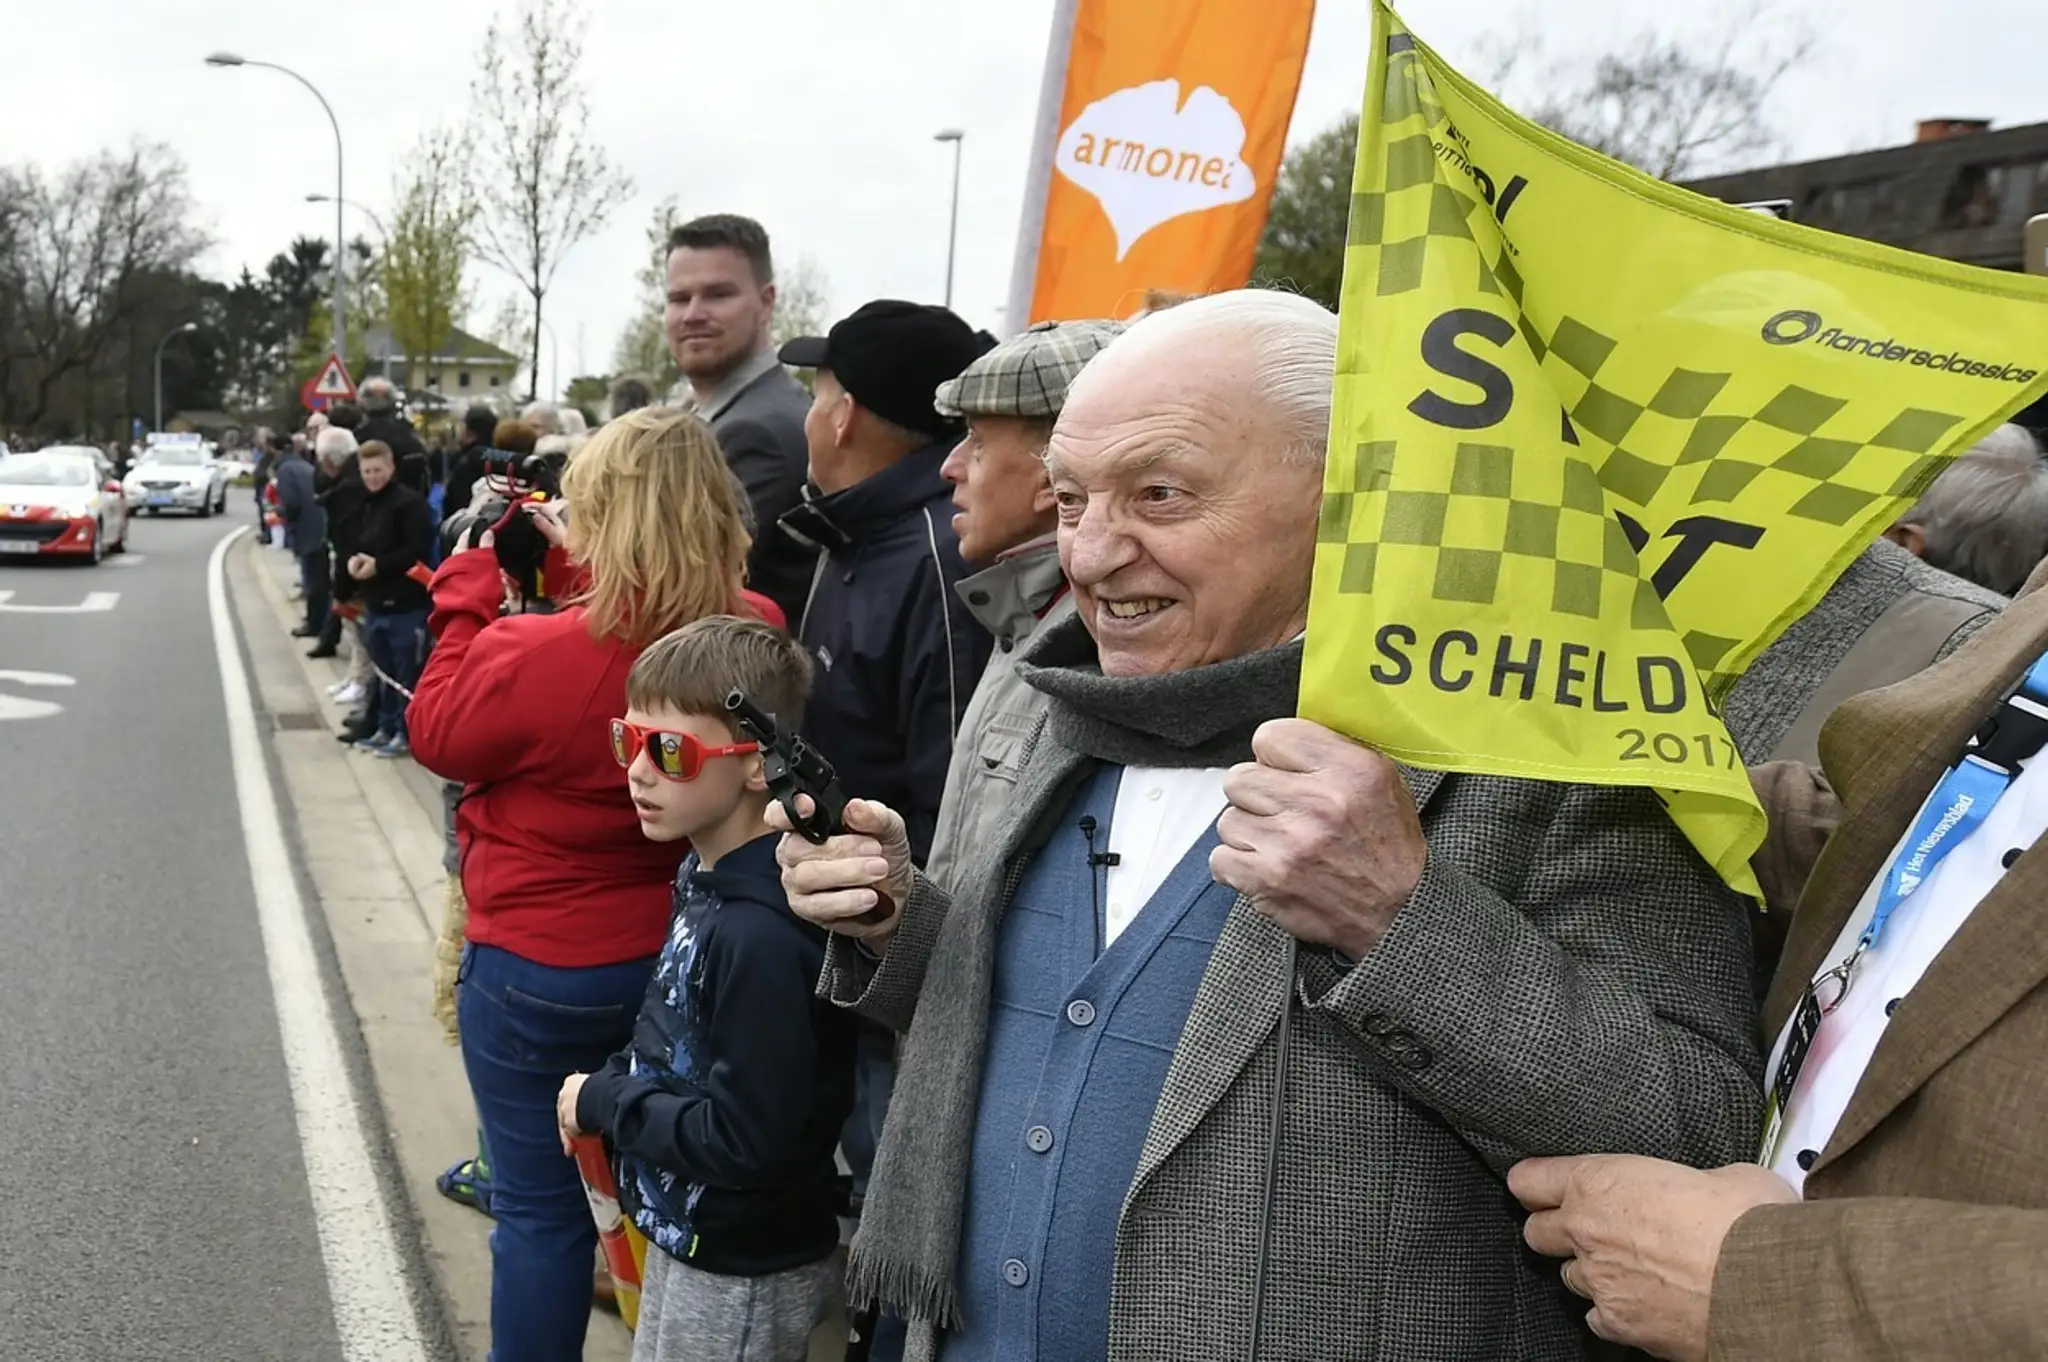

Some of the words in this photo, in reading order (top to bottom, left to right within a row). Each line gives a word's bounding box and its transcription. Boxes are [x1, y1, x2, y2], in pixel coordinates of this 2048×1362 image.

[1816, 328, 2038, 384] flandersclassics
[1370, 624, 1720, 716] SCHELD
[1615, 728, 1735, 771] 2017
[1905, 852, 1927, 872] Het
[1917, 793, 1975, 853] Nieuwsblad
